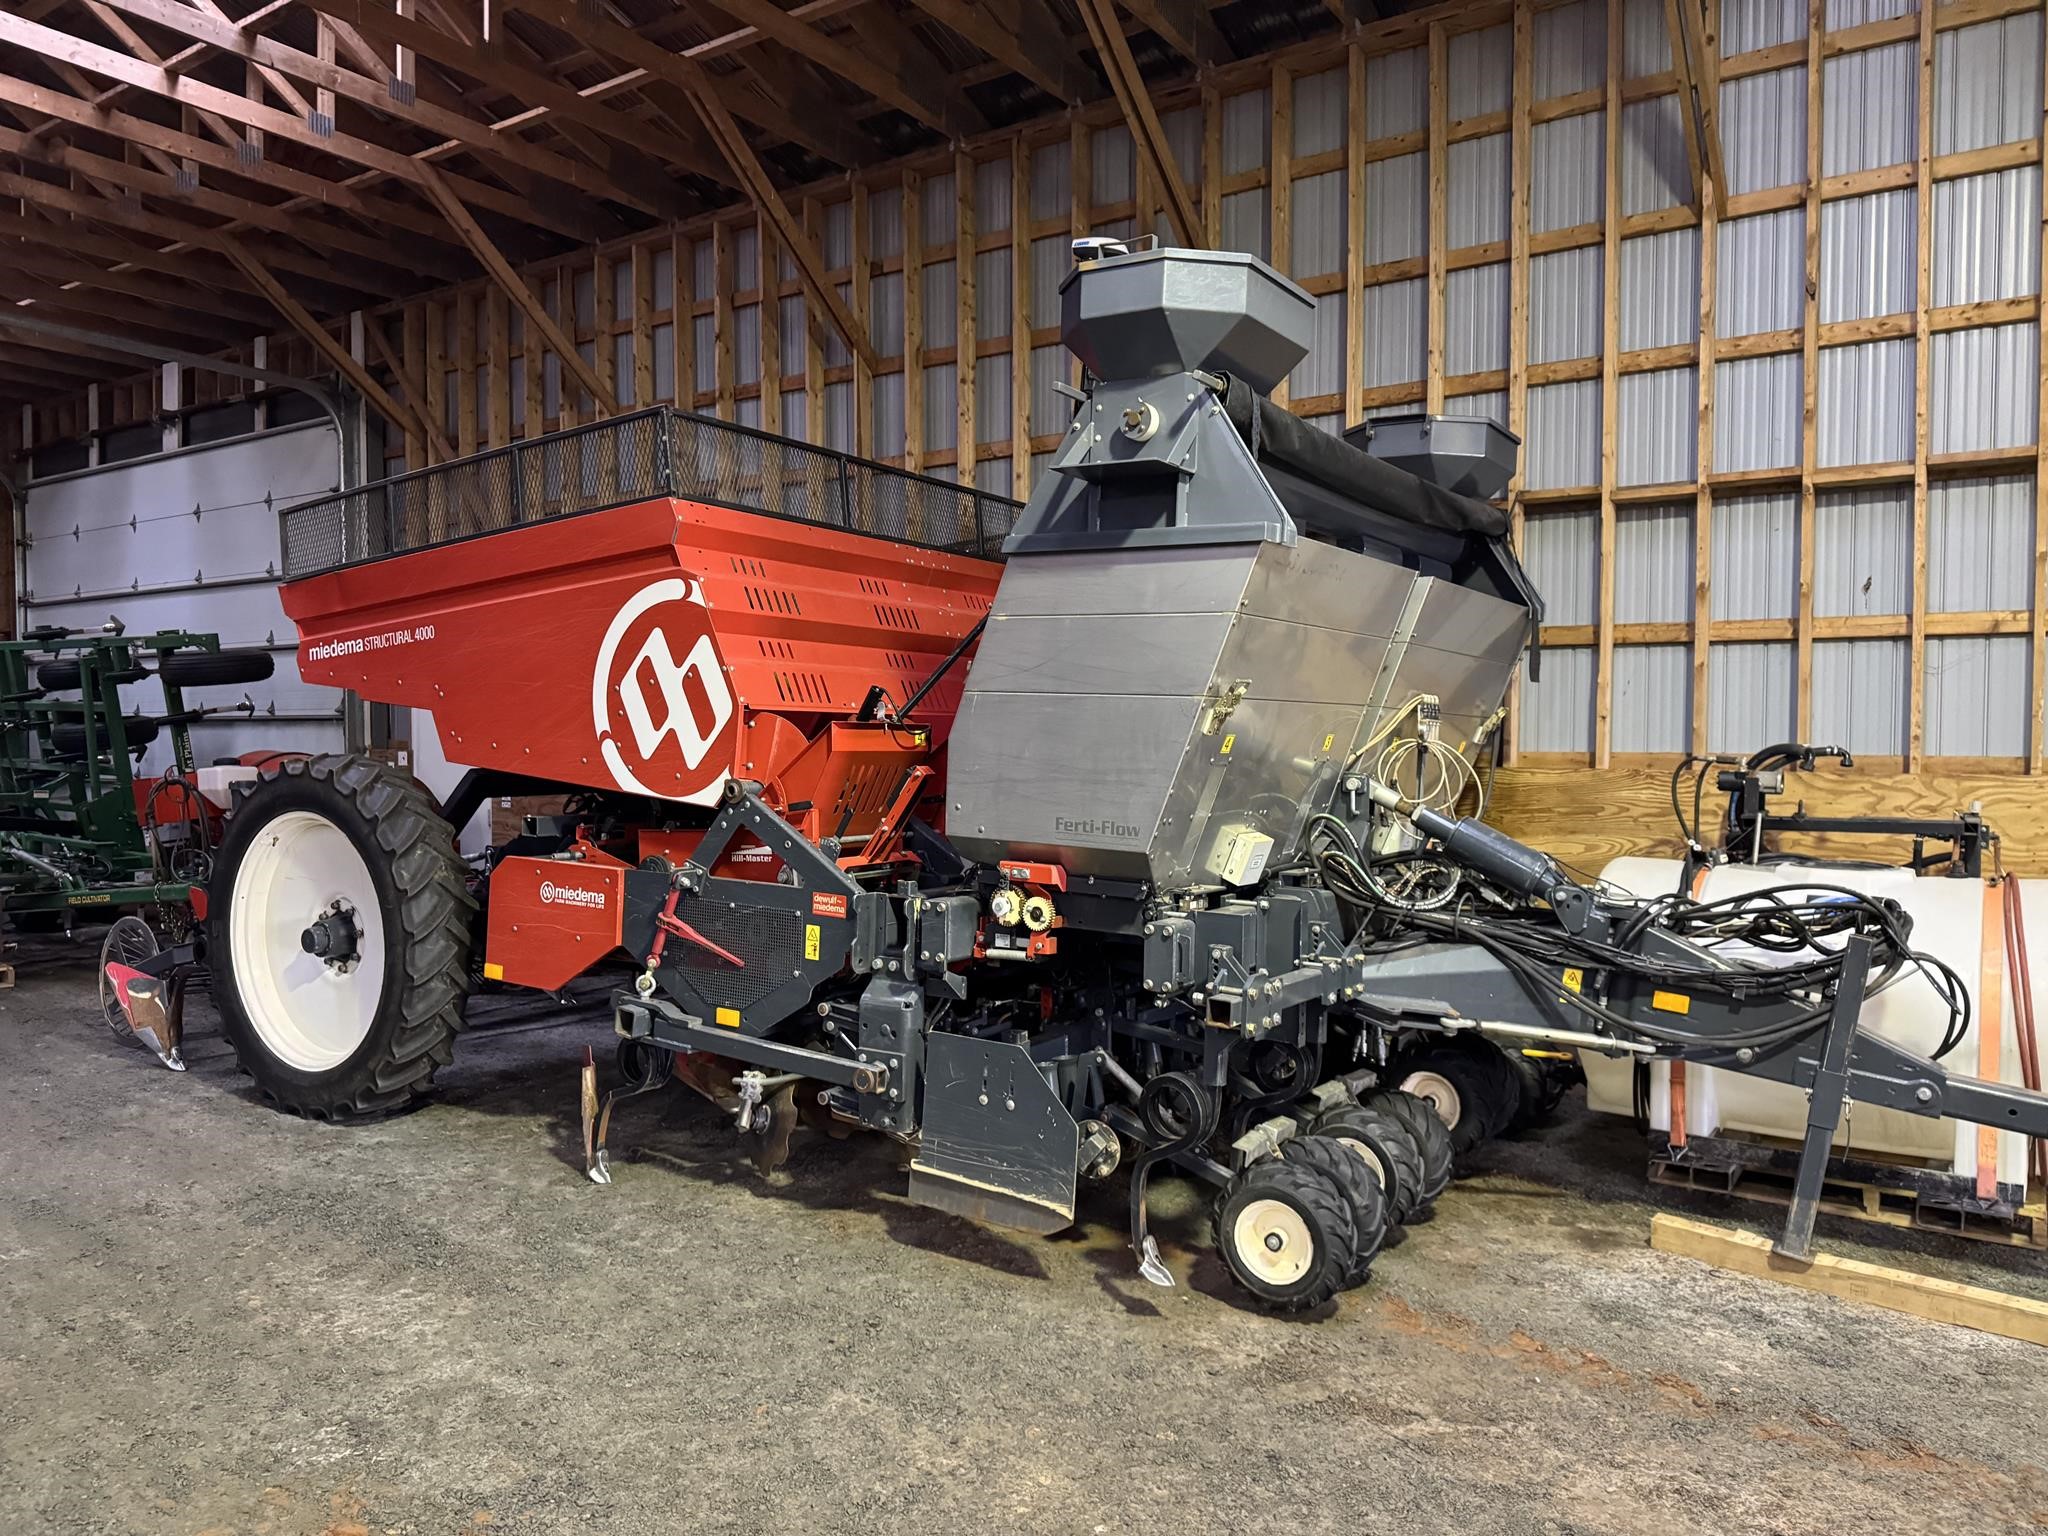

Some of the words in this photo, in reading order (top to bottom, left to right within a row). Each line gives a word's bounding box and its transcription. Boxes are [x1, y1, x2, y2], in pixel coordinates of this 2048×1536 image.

[309, 638, 363, 661] miedema
[364, 629, 414, 651] STRUCTURAL
[415, 625, 435, 641] 4000
[183, 731, 192, 758] Plains
[1055, 816, 1140, 837] Ferti-Flow
[731, 854, 773, 863] Hill-Master
[68, 896, 81, 904] FIELD
[555, 886, 605, 904] miedema
[813, 903, 845, 914] miedema
